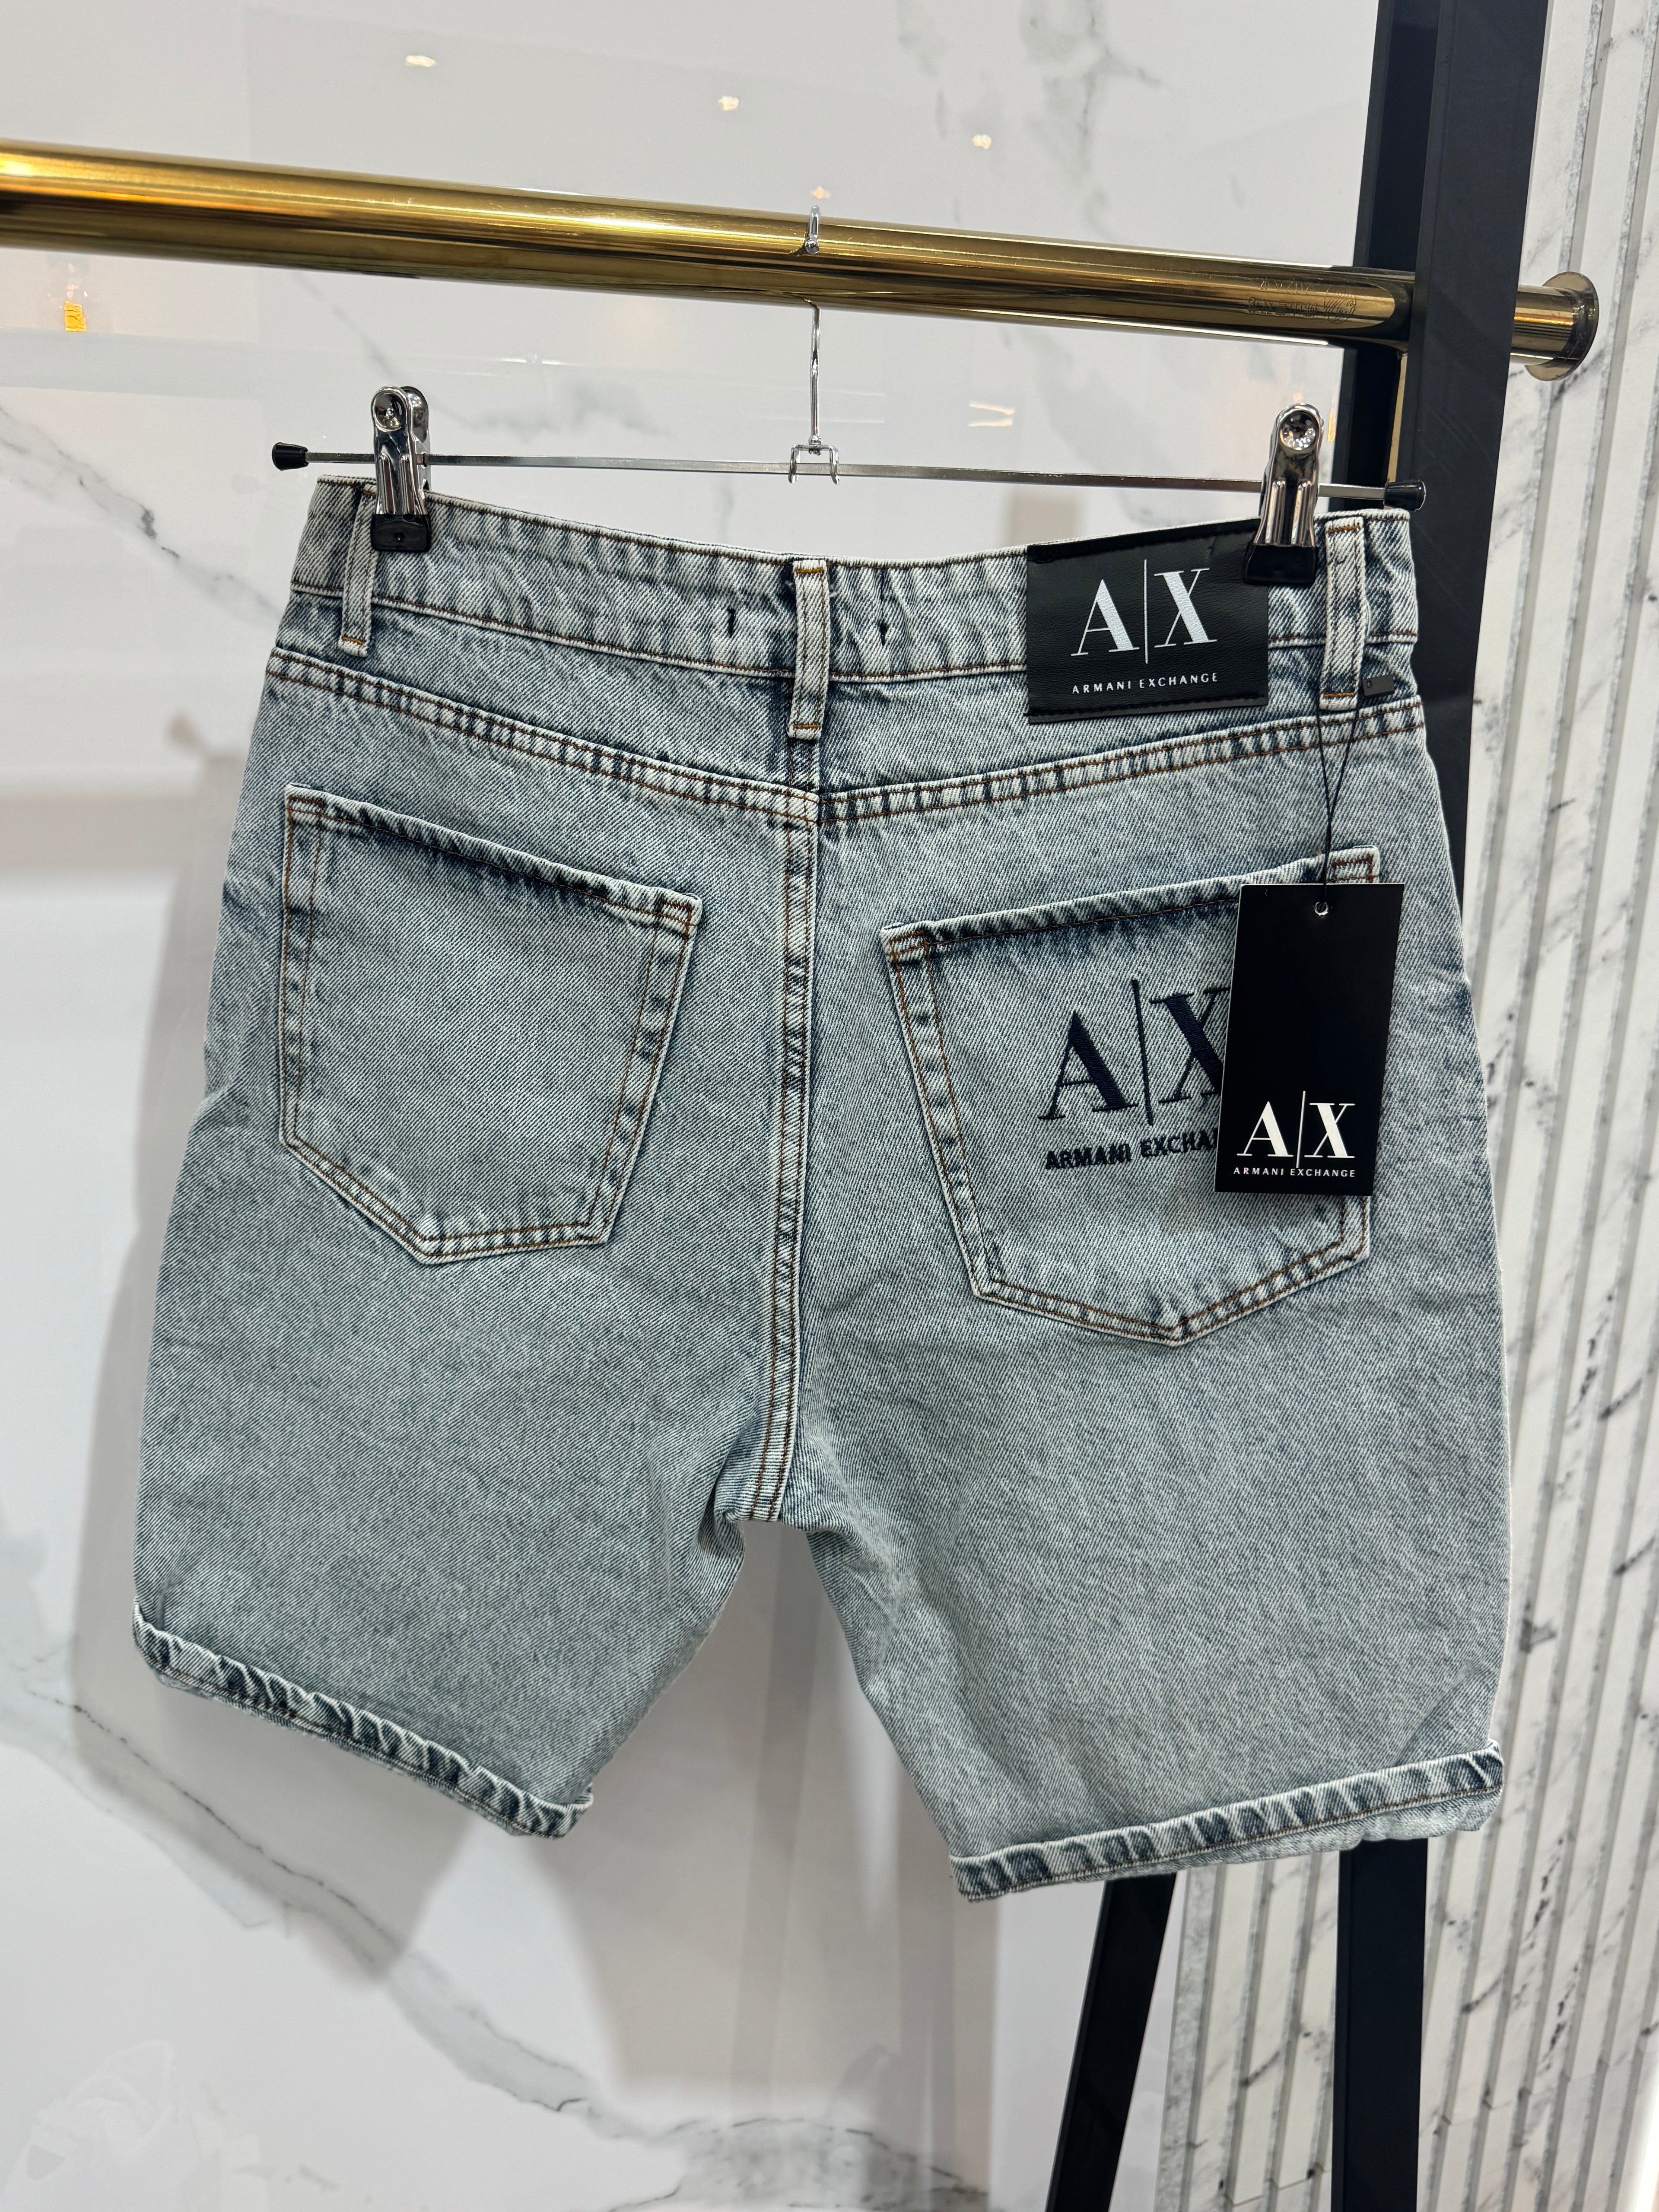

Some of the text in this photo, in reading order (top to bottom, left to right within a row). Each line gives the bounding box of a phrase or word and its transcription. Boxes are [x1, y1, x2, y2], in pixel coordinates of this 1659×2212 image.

[1072, 672, 1218, 694] ARMANI EXCHANGE
[1045, 1128, 1219, 1170] ARMANI EXCHA
[1233, 1166, 1356, 1177] ARMANI EXCHANGE
